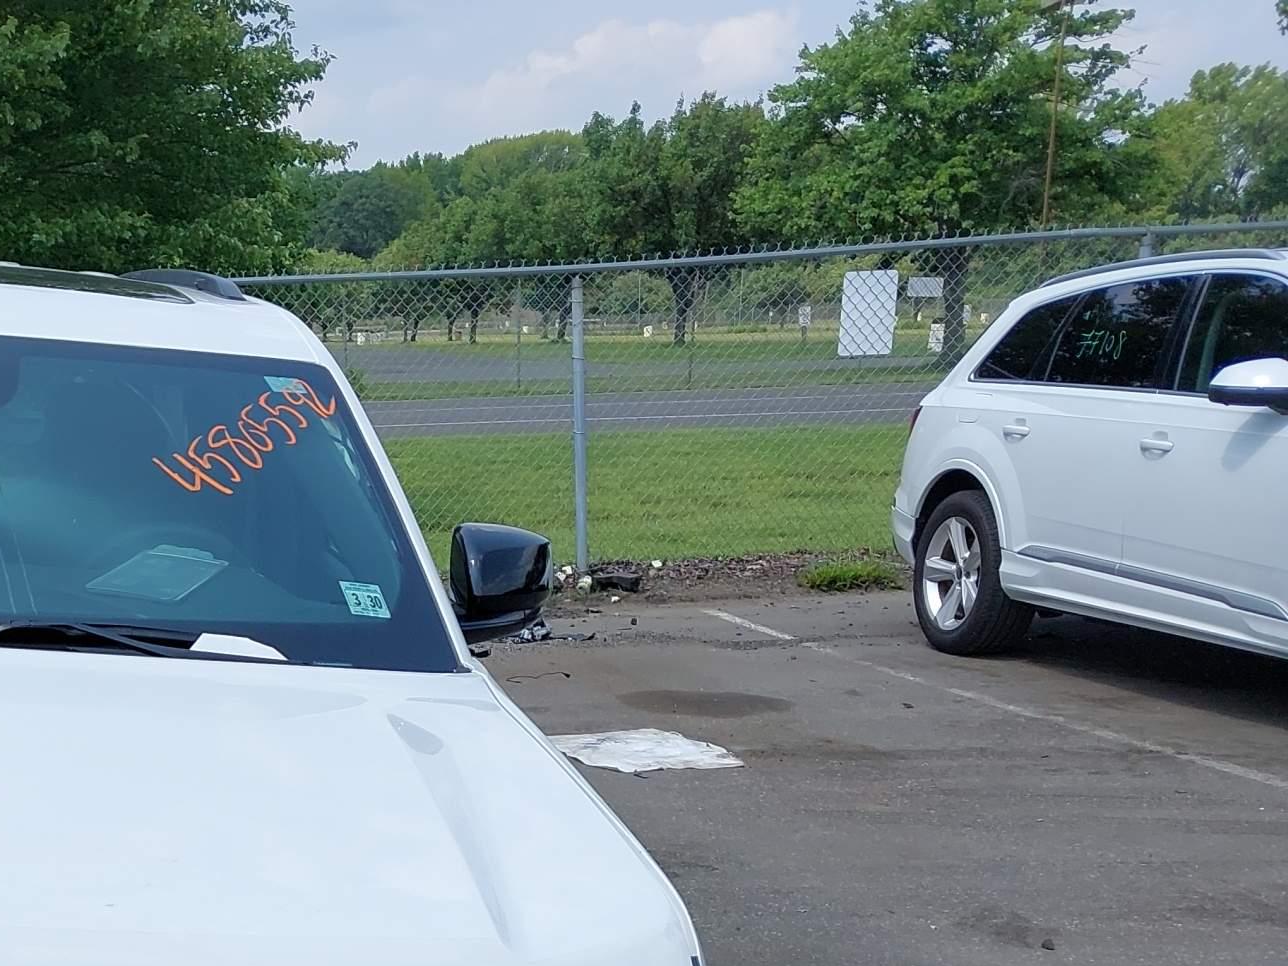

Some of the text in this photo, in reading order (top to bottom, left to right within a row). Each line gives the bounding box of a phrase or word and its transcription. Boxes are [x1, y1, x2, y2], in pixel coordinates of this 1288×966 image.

[151, 377, 337, 495] 45805592
[352, 593, 383, 609] 3 30
